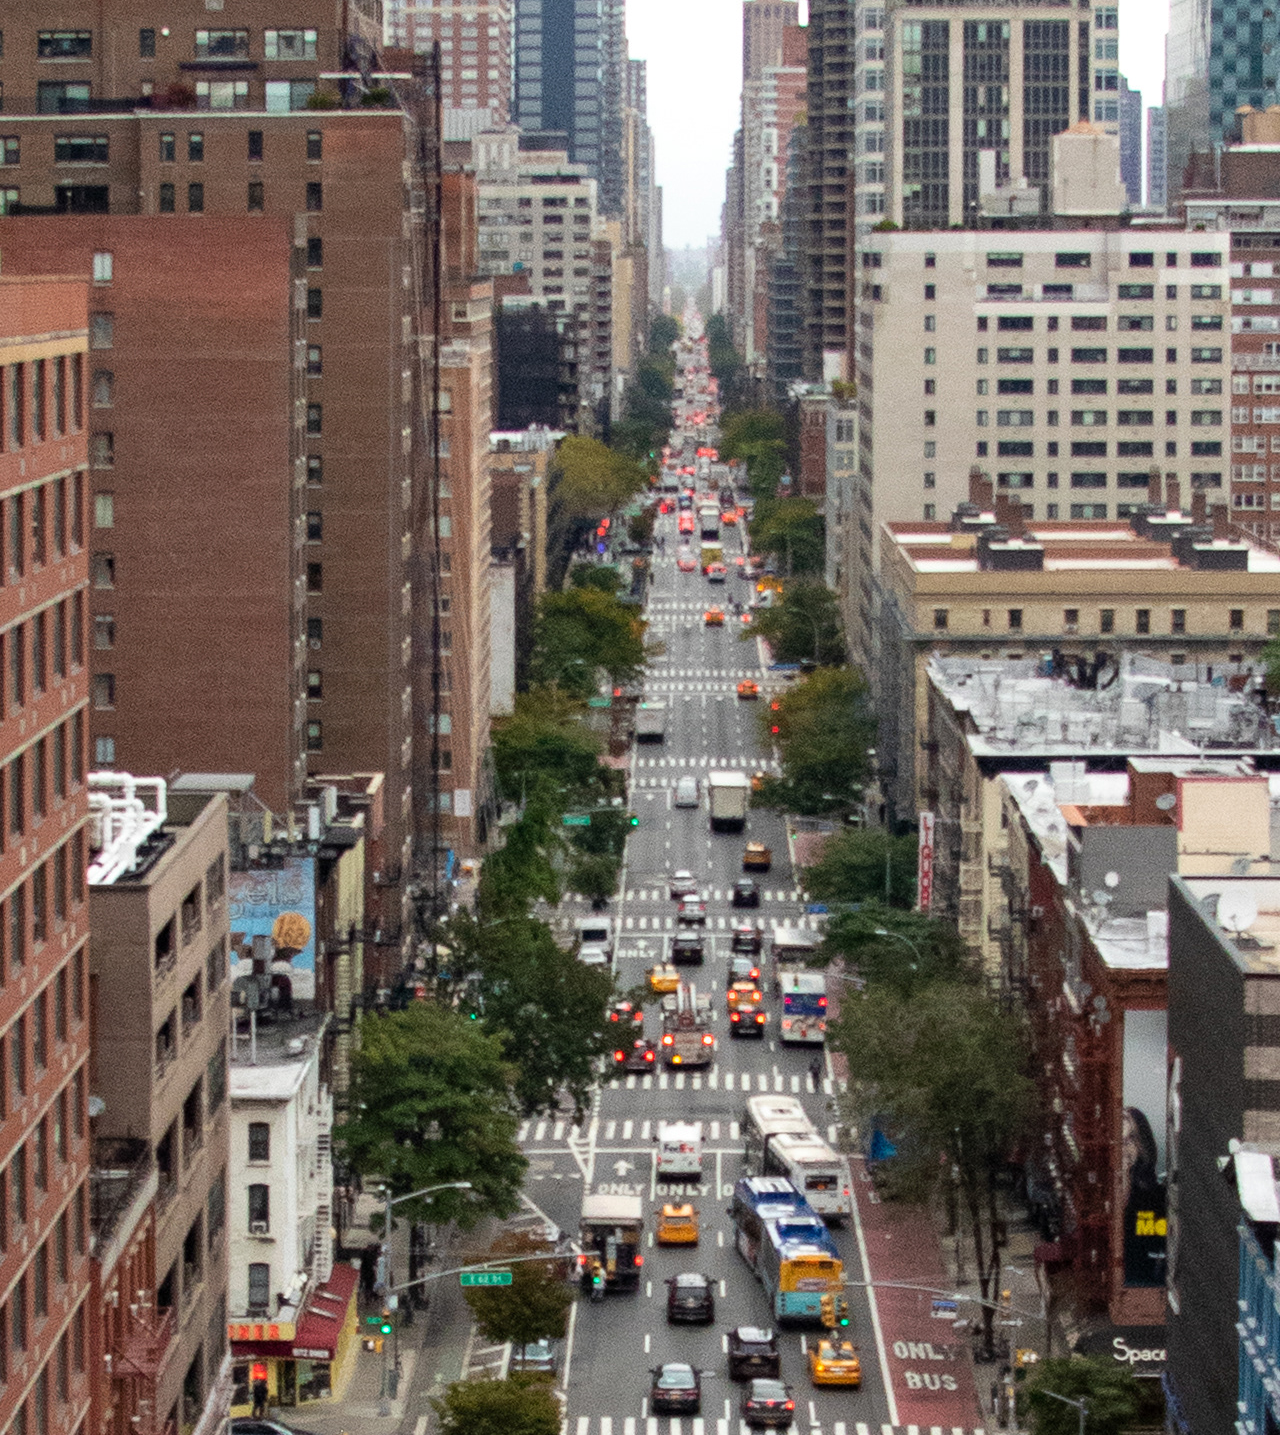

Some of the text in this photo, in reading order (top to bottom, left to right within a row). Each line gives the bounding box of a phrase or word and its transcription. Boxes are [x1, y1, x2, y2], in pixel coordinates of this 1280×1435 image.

[663, 1143, 695, 1154] FedEx
[598, 1183, 646, 1196] ONLY
[656, 1183, 712, 1197] ONLY
[228, 1324, 279, 1340] INER
[904, 1371, 958, 1391] BUS
